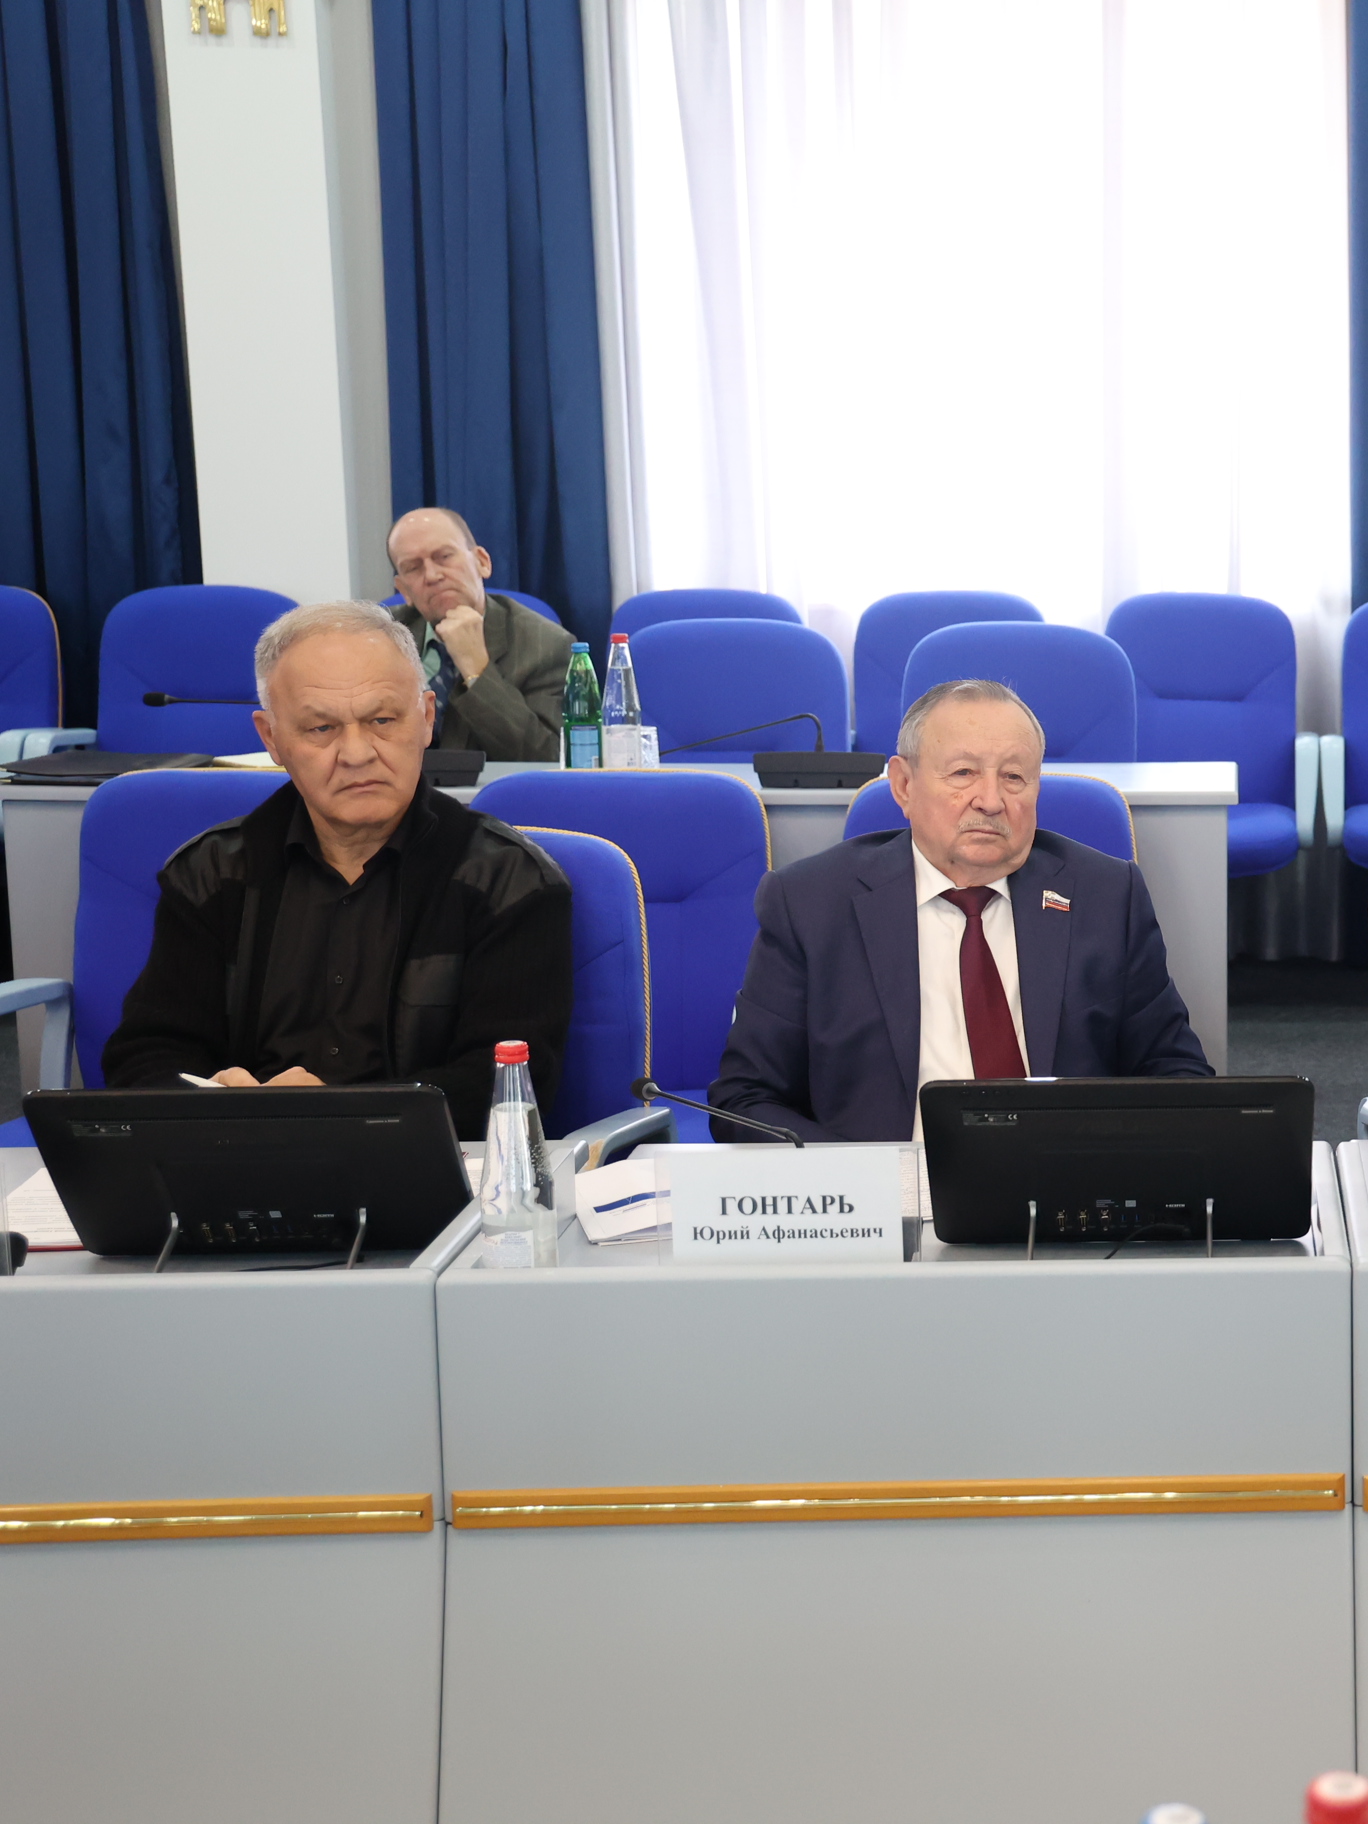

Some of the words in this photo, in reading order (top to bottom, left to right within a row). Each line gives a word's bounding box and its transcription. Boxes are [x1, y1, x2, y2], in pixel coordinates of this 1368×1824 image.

[719, 1194, 856, 1217] ГОНТАРЬ
[692, 1225, 751, 1245] Юрий
[757, 1225, 884, 1244] Афанасьевич
